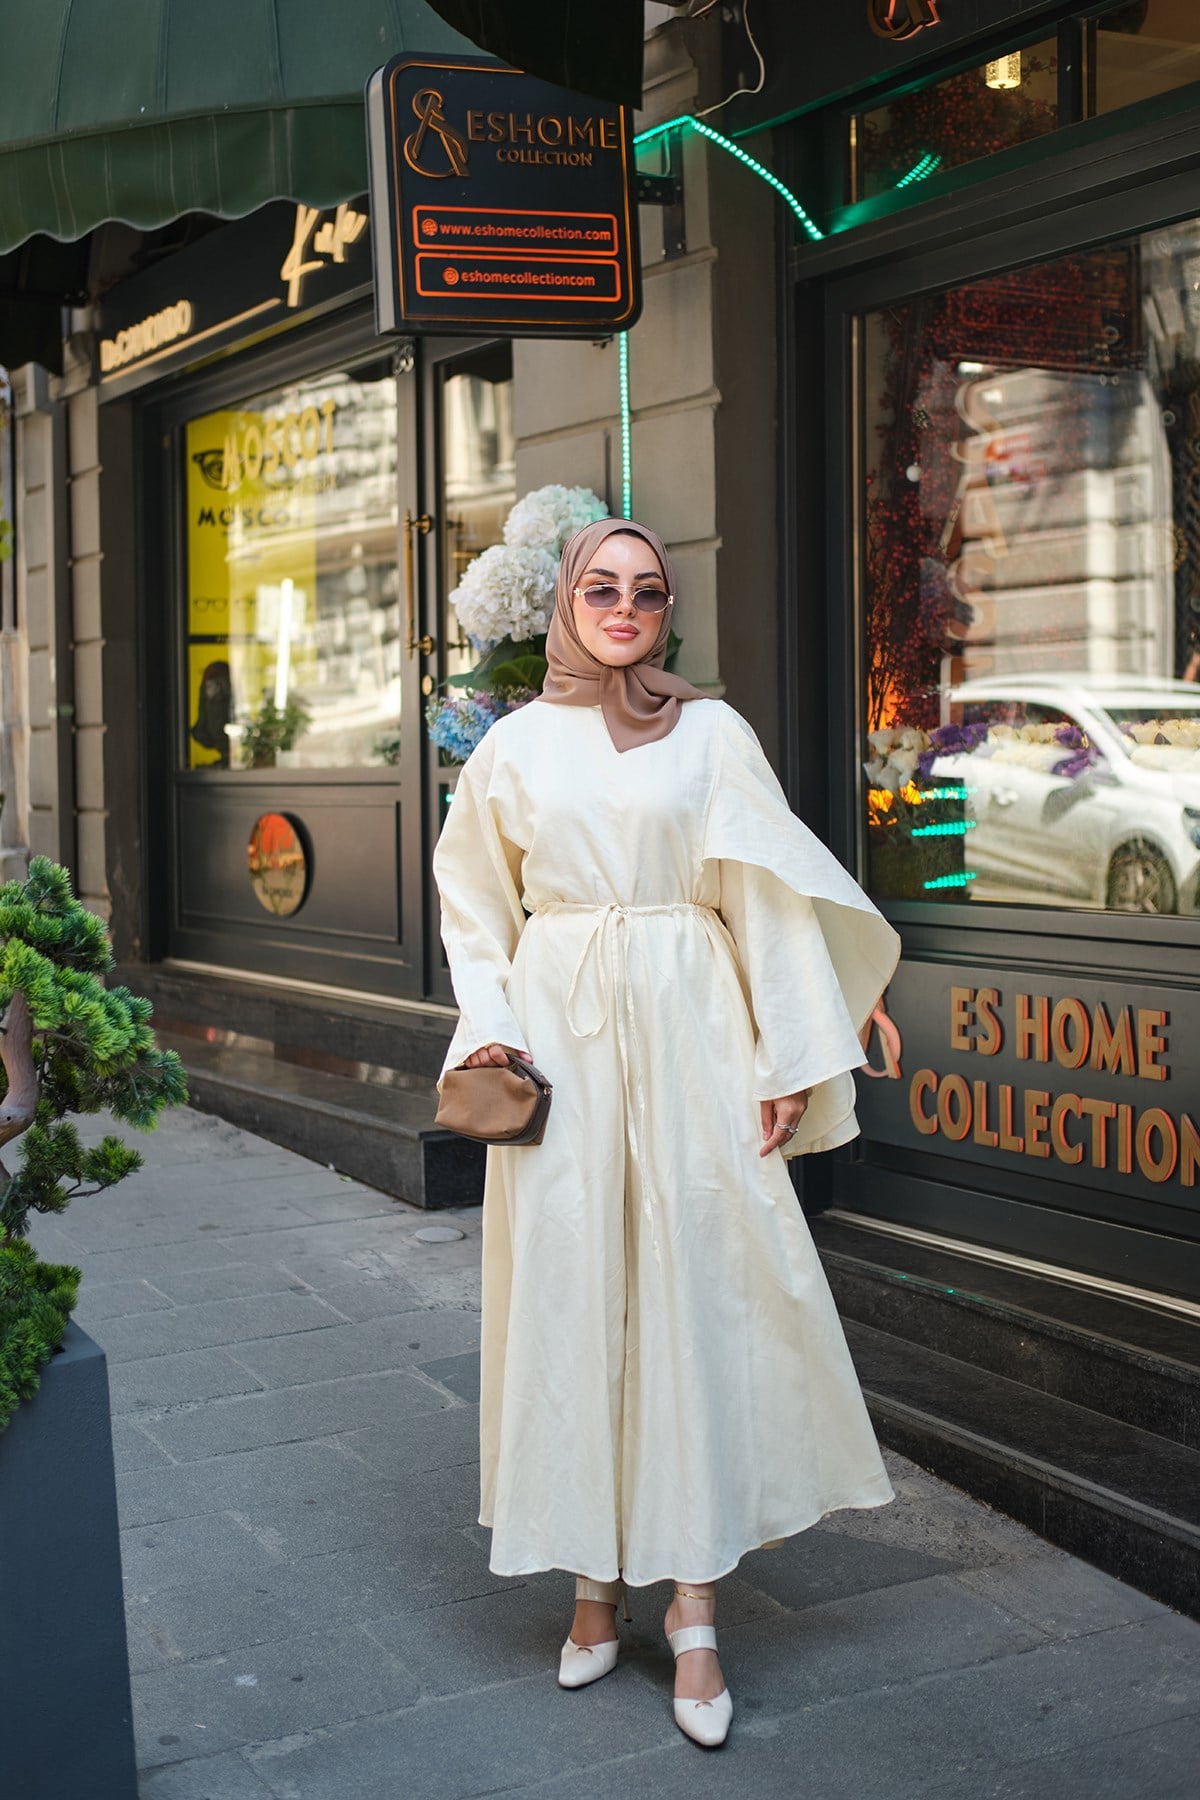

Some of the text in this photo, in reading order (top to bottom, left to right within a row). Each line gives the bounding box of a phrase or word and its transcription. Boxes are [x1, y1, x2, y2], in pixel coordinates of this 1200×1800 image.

[466, 110, 618, 149] ESHOME
[496, 149, 593, 166] COLLECTION
[440, 223, 611, 241] www.eshomecollection.com
[461, 270, 596, 287] eshomecollectioncom
[221, 400, 336, 489] MOSCOT
[951, 986, 1167, 1081] ES HOME
